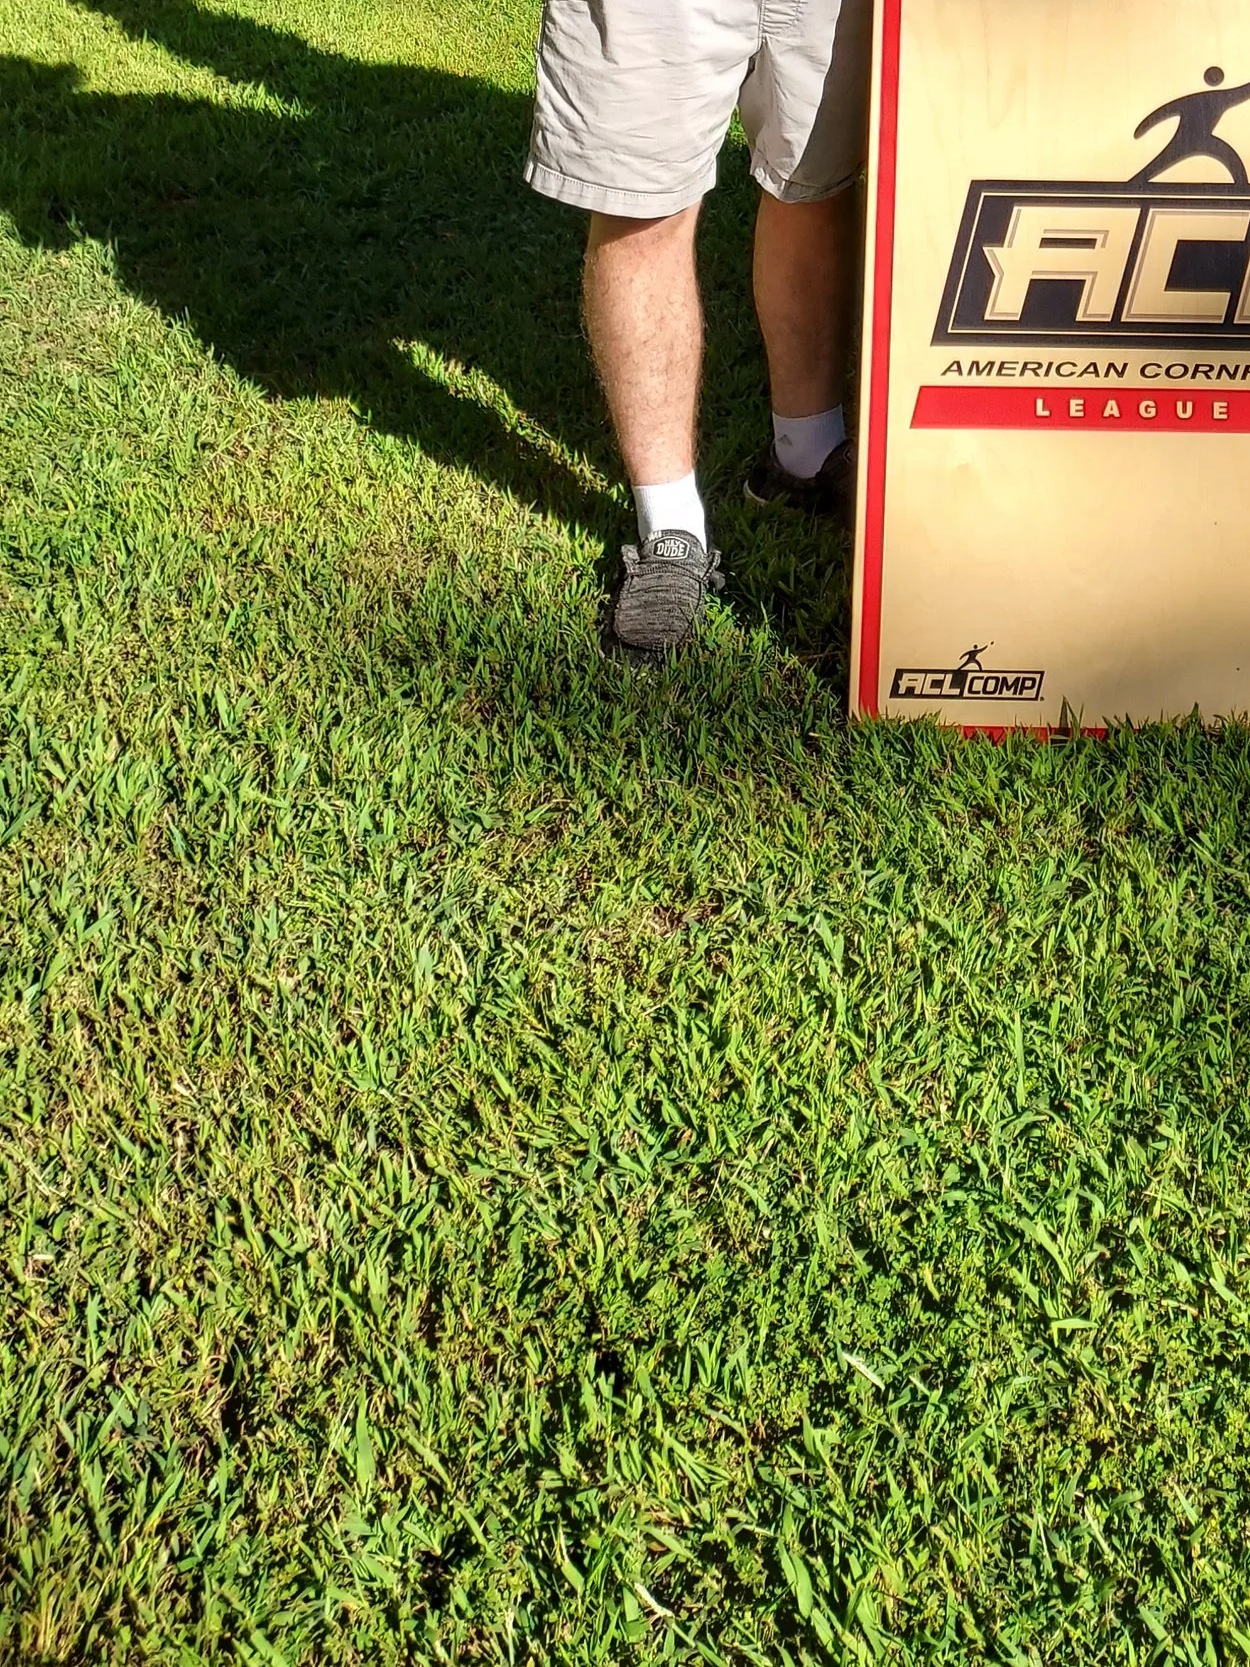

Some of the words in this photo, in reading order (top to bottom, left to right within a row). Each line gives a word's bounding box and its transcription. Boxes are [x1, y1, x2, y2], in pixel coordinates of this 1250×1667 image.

[940, 360, 1129, 380] AMERICAN
[1036, 397, 1230, 420] LEAGUE
[656, 543, 685, 557] DUDE
[898, 672, 961, 696] ACL
[967, 676, 1037, 696] COMP
